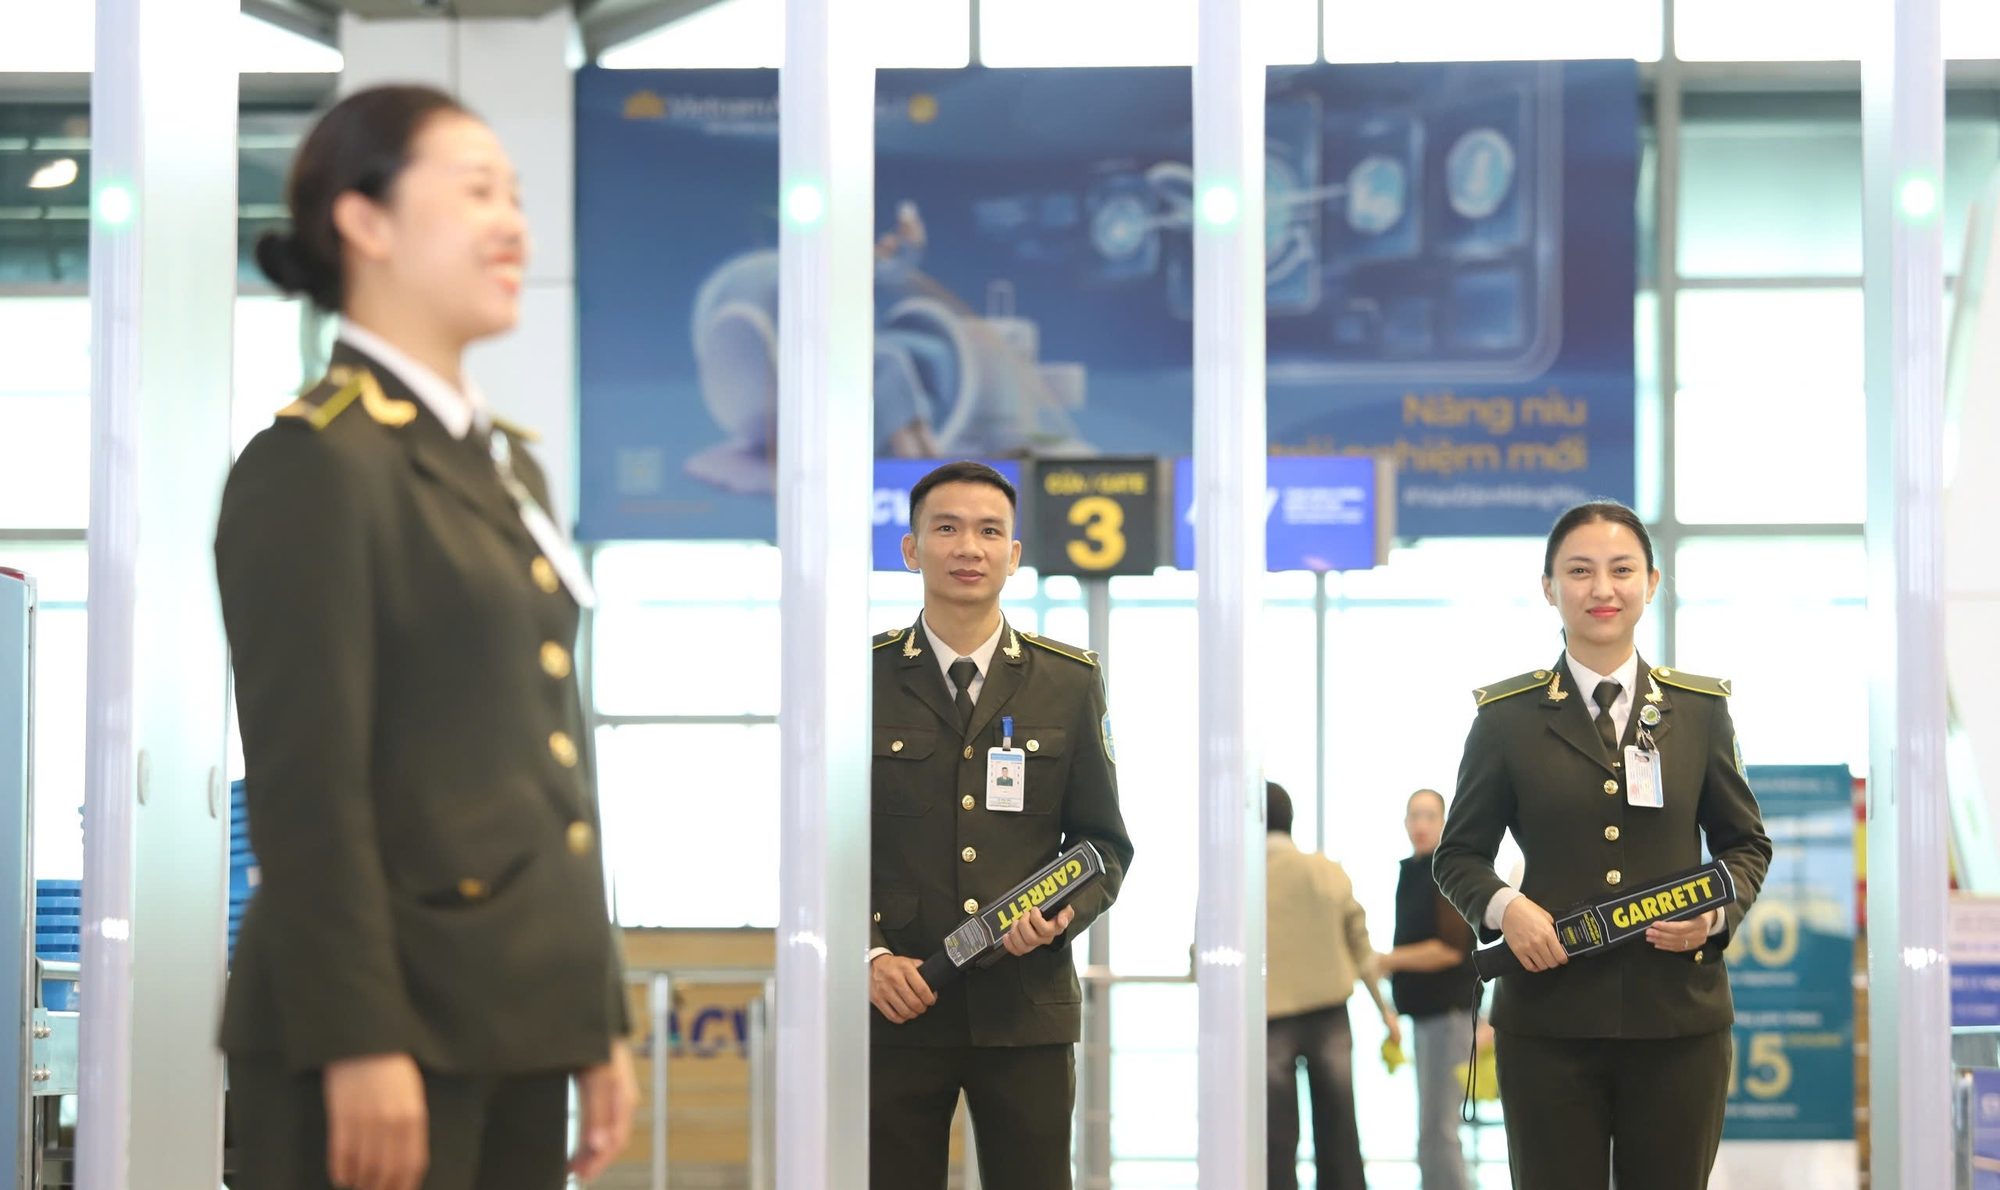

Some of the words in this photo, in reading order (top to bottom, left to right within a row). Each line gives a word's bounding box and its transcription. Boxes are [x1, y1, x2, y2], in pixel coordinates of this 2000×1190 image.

[1066, 496, 1126, 570] 3
[997, 859, 1082, 930] GARRETT
[1612, 876, 1713, 928] GARRETT
